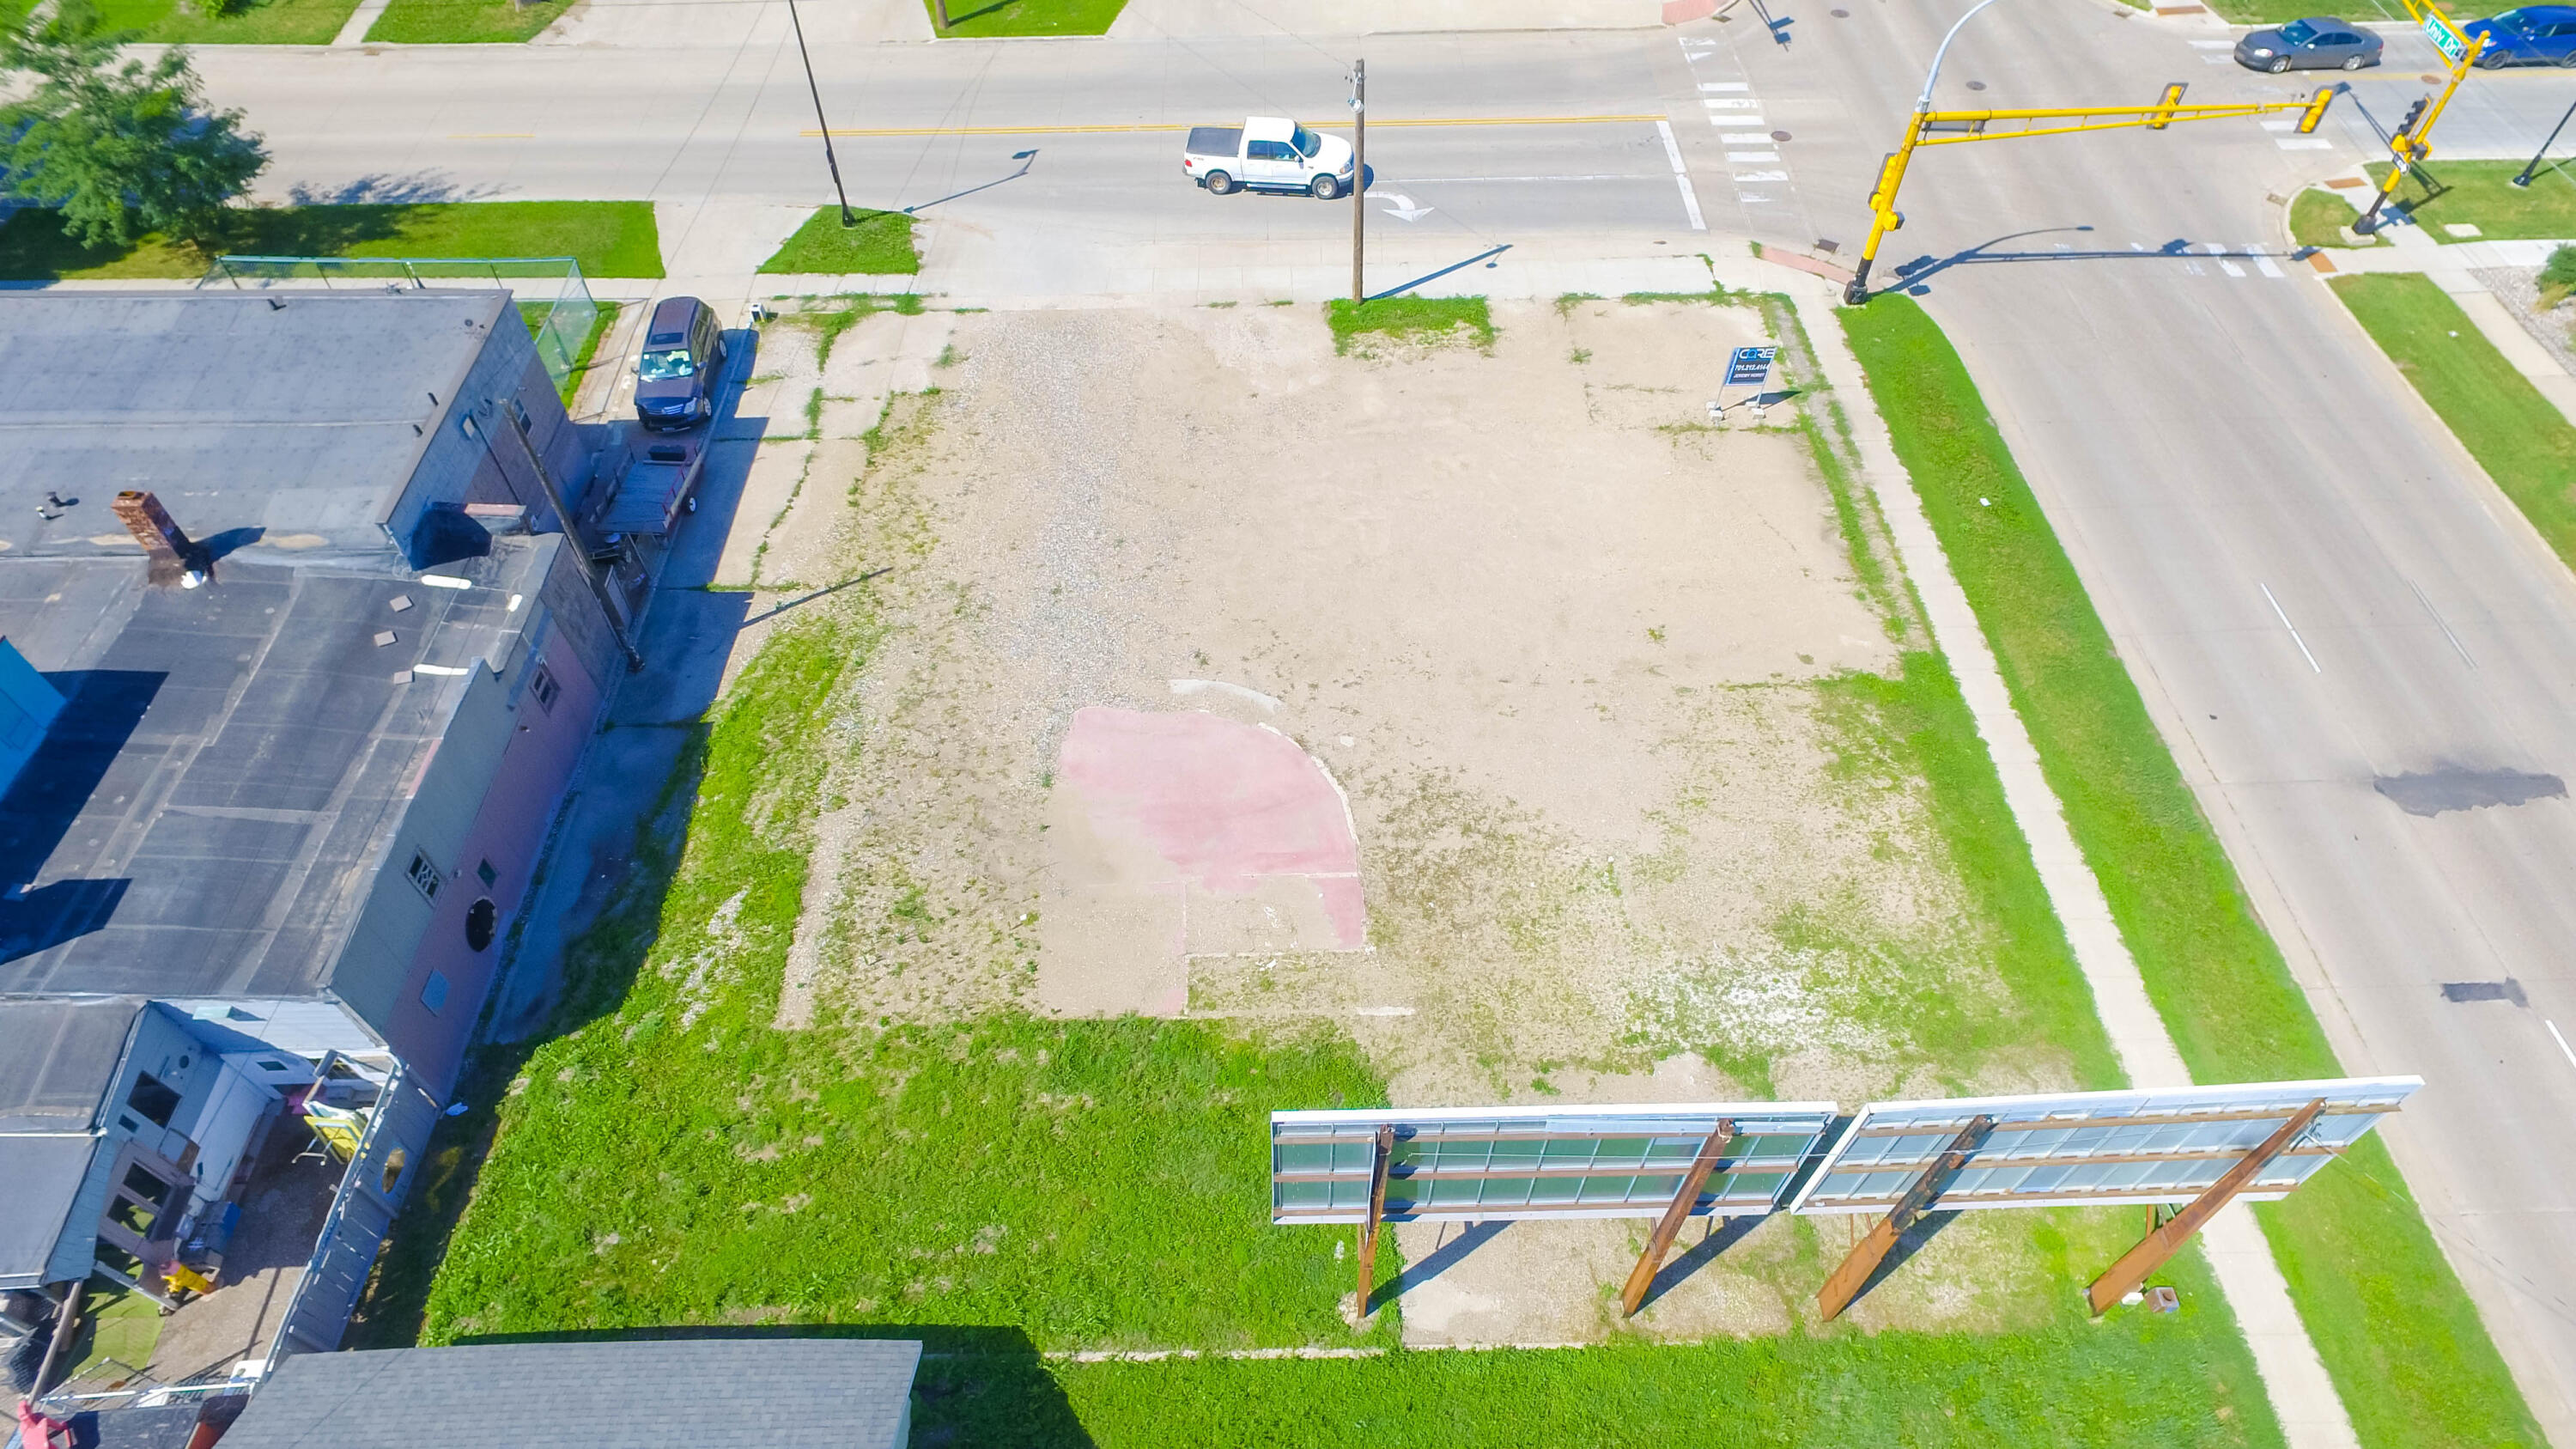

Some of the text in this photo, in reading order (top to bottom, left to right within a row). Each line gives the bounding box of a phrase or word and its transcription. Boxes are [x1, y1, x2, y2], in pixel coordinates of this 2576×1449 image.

[2426, 17, 2456, 55] Univ Dr
[1739, 348, 1775, 359] CORE
